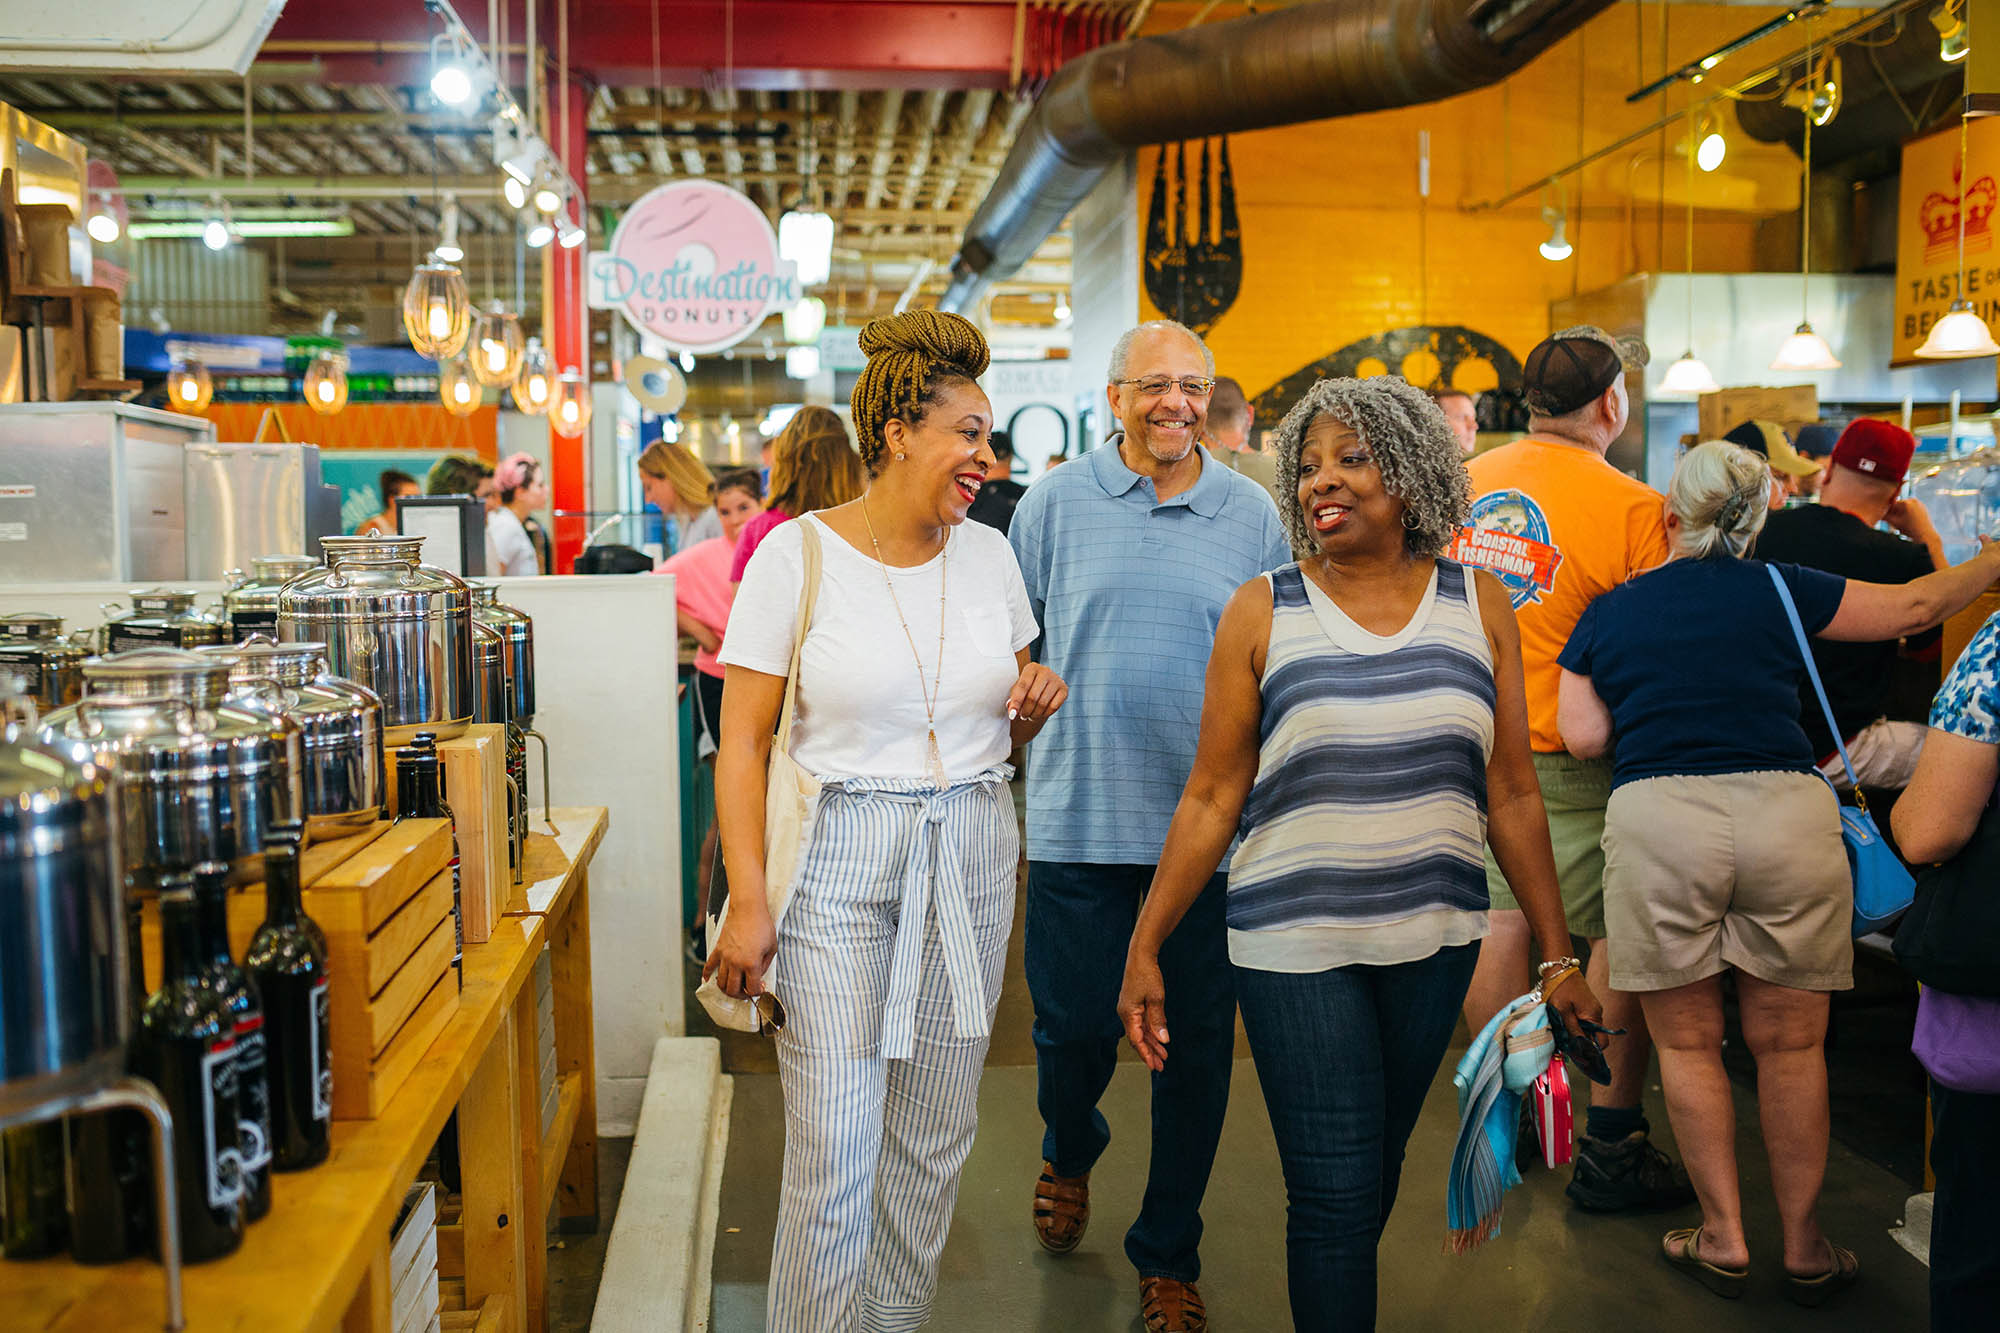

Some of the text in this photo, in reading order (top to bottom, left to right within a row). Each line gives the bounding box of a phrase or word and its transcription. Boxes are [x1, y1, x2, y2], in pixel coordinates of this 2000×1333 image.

[592, 257, 794, 302] Destination
[1910, 267, 1979, 304] TASTE
[643, 306, 752, 325] DONUTS
[1457, 538, 1536, 575] FISHERMAN
[1471, 526, 1529, 557] COASTAL
